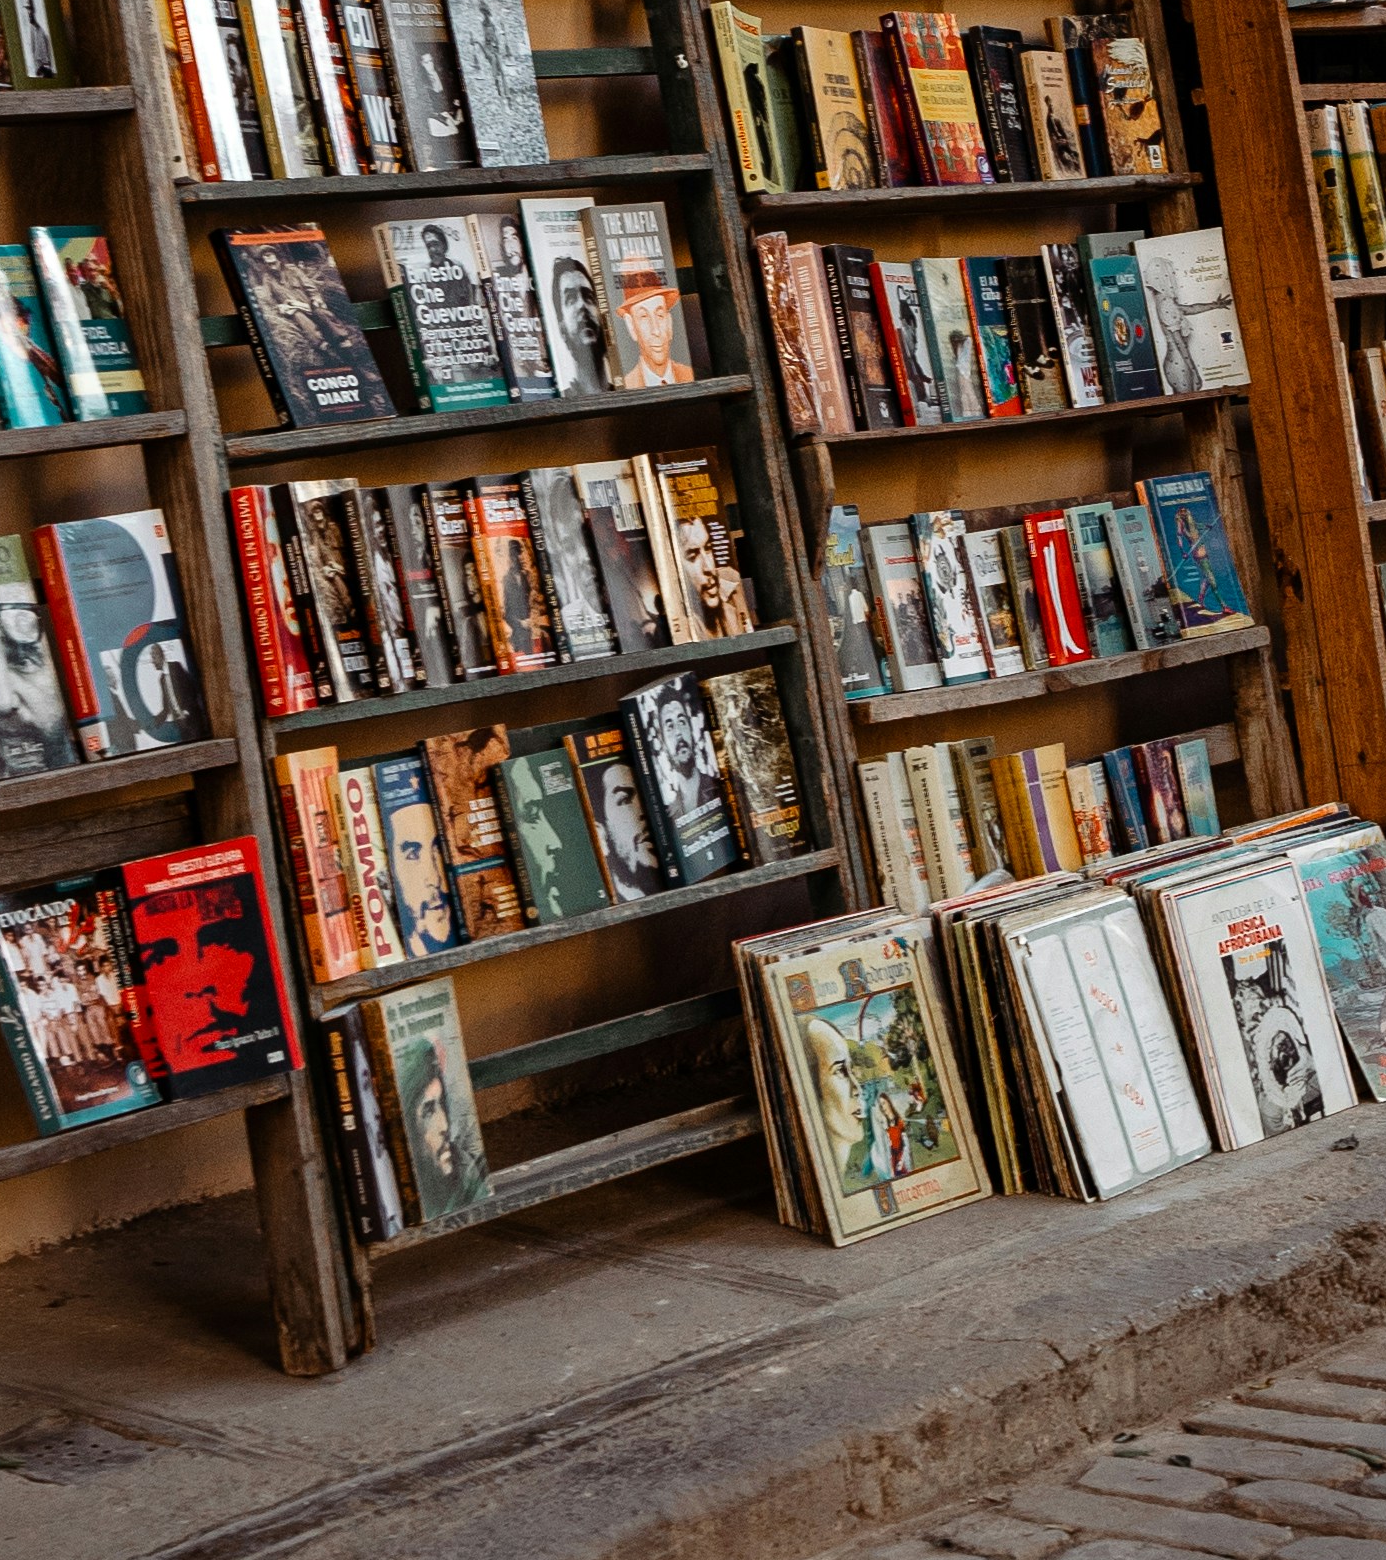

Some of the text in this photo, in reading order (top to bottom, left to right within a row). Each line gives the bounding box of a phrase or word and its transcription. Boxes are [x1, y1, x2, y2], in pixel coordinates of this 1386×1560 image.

[734, 109, 754, 171] Afrocubanas
[601, 213, 623, 234] THE
[622, 210, 658, 234] MAFIA
[606, 235, 663, 260] IN HAVANA
[405, 262, 463, 284] Ernesto
[410, 284, 445, 304] Che
[416, 305, 483, 325] Guevara
[821, 263, 857, 359] EL PUEBLO CUBANO
[89, 340, 130, 355] ANDELA
[235, 304, 276, 379] CONGO DIARY
[307, 375, 359, 391] CONGO
[316, 390, 360, 406] DIARY
[519, 478, 546, 551] CHE GUEVARA
[235, 495, 273, 661] EL DIARIO DEL CHE EN BOLIVIA
[541, 572, 565, 633] Notas de Viaje
[346, 778, 393, 957] POMBO
[353, 894, 370, 948] POMBO
[1212, 896, 1276, 923] ANTOLOGIA DE LA
[1227, 915, 1266, 936] MUSICA
[1218, 925, 1283, 955] AFROCUBANA
[11, 1033, 54, 1120] EVOCANDO AL
